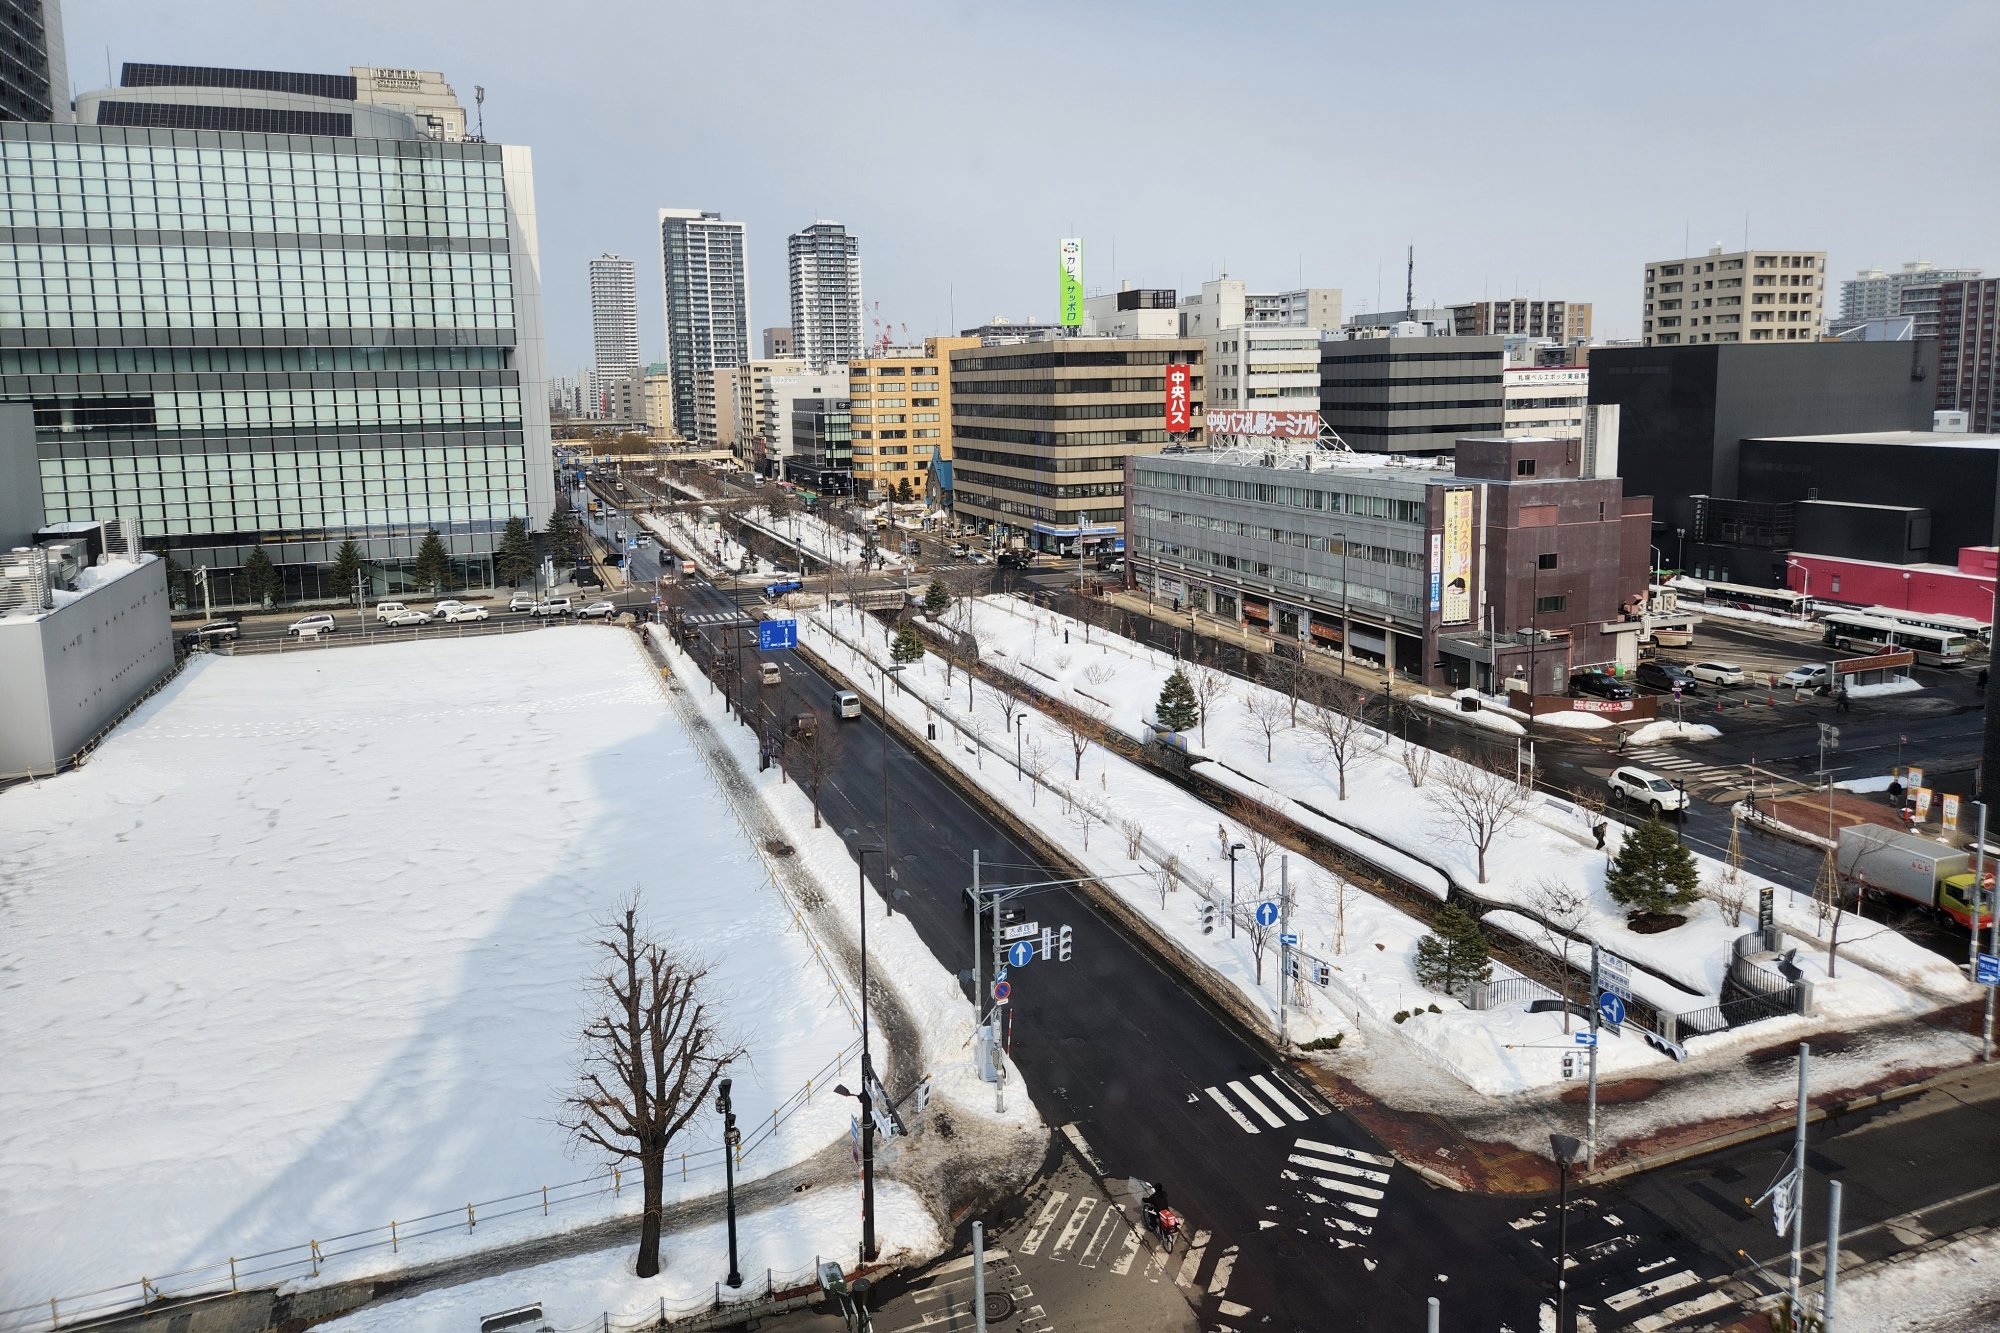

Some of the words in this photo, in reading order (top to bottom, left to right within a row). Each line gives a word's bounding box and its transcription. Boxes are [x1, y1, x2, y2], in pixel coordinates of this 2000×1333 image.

[1518, 373, 1589, 381] 札幌ベルエポック美容専
[1171, 371, 1185, 424] 中央バス
[1206, 411, 1317, 436] 中央バス札幌ターミナル
[1460, 494, 1470, 576] 高速バスのりば
[1009, 925, 1031, 934] 大通西
[1601, 952, 1623, 967] 大通西
[1598, 979, 1631, 1000] 時差式信号機
